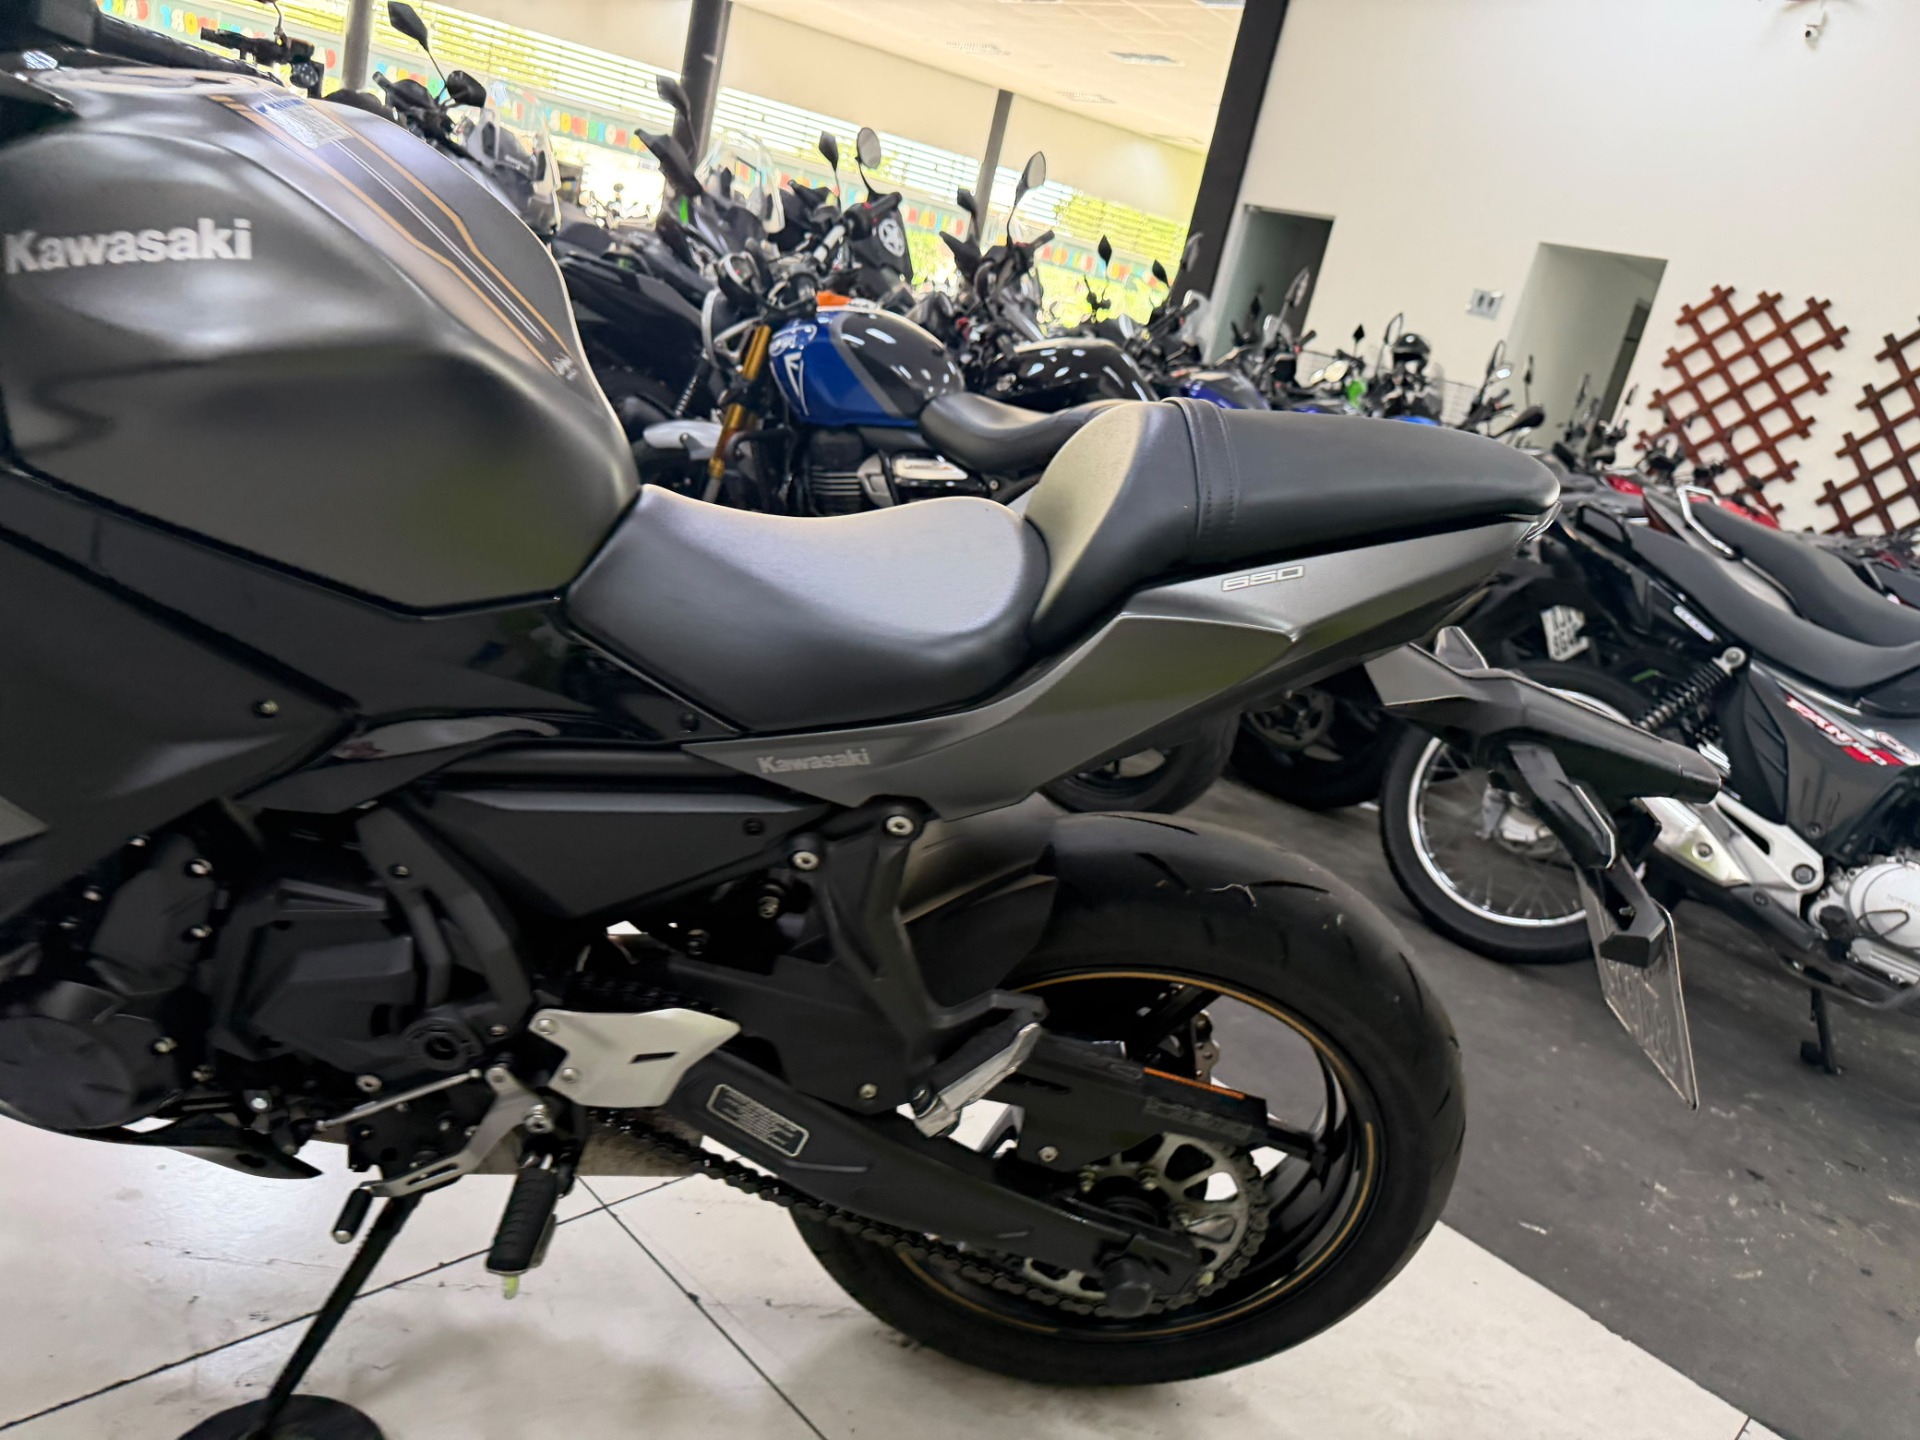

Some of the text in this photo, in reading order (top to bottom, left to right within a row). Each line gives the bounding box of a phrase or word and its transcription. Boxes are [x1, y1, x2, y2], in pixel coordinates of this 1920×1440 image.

[4, 217, 253, 275] Kawasaki
[1221, 564, 1305, 592] 650
[757, 748, 871, 773] Kawasaki
